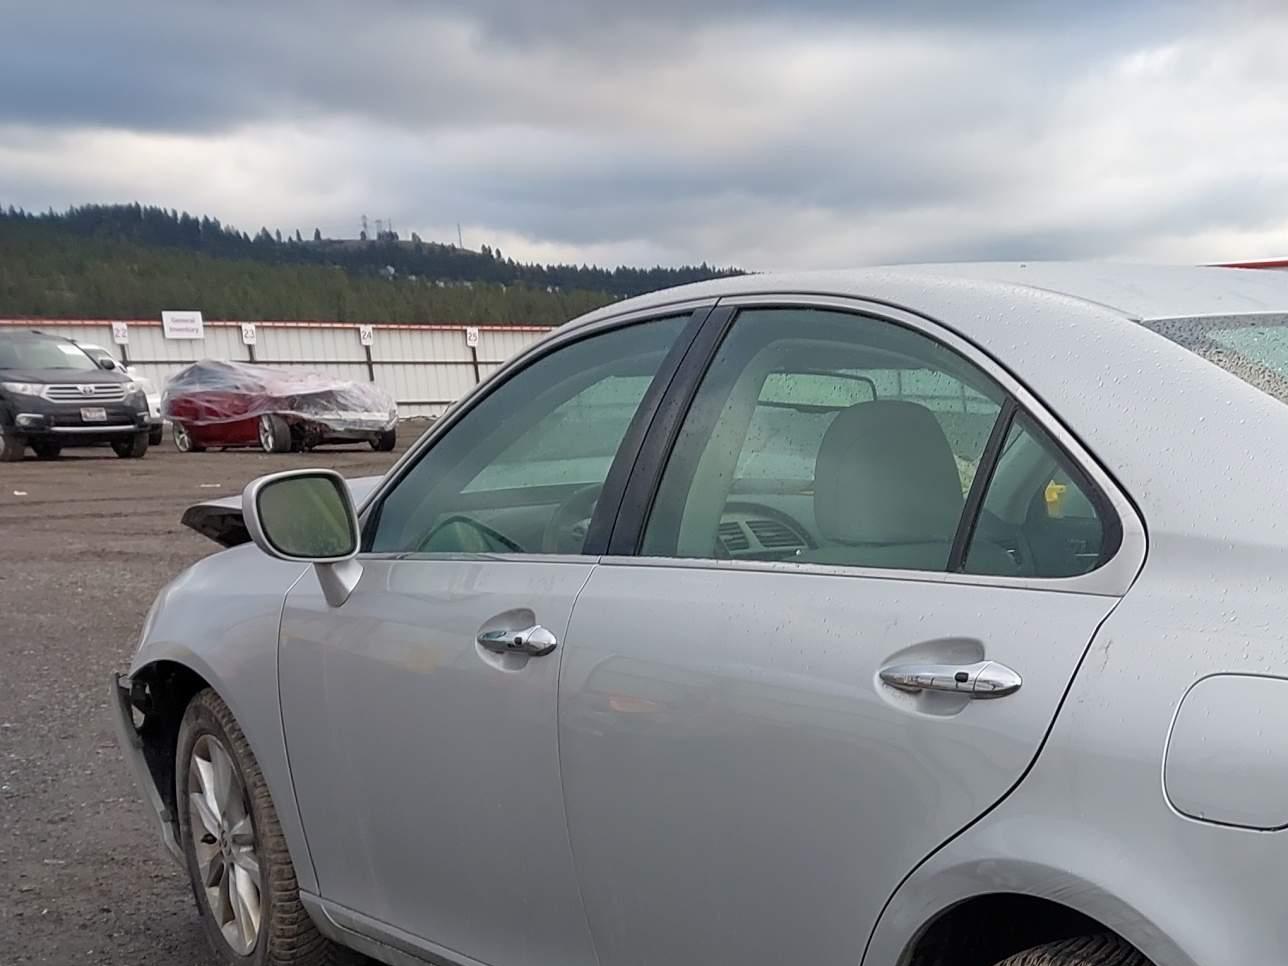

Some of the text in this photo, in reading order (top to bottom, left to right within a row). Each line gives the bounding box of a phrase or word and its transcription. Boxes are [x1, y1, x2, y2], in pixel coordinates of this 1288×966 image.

[115, 328, 127, 338] 22
[244, 328, 255, 338] 23
[362, 329, 372, 339] 24
[467, 331, 477, 342] 25
